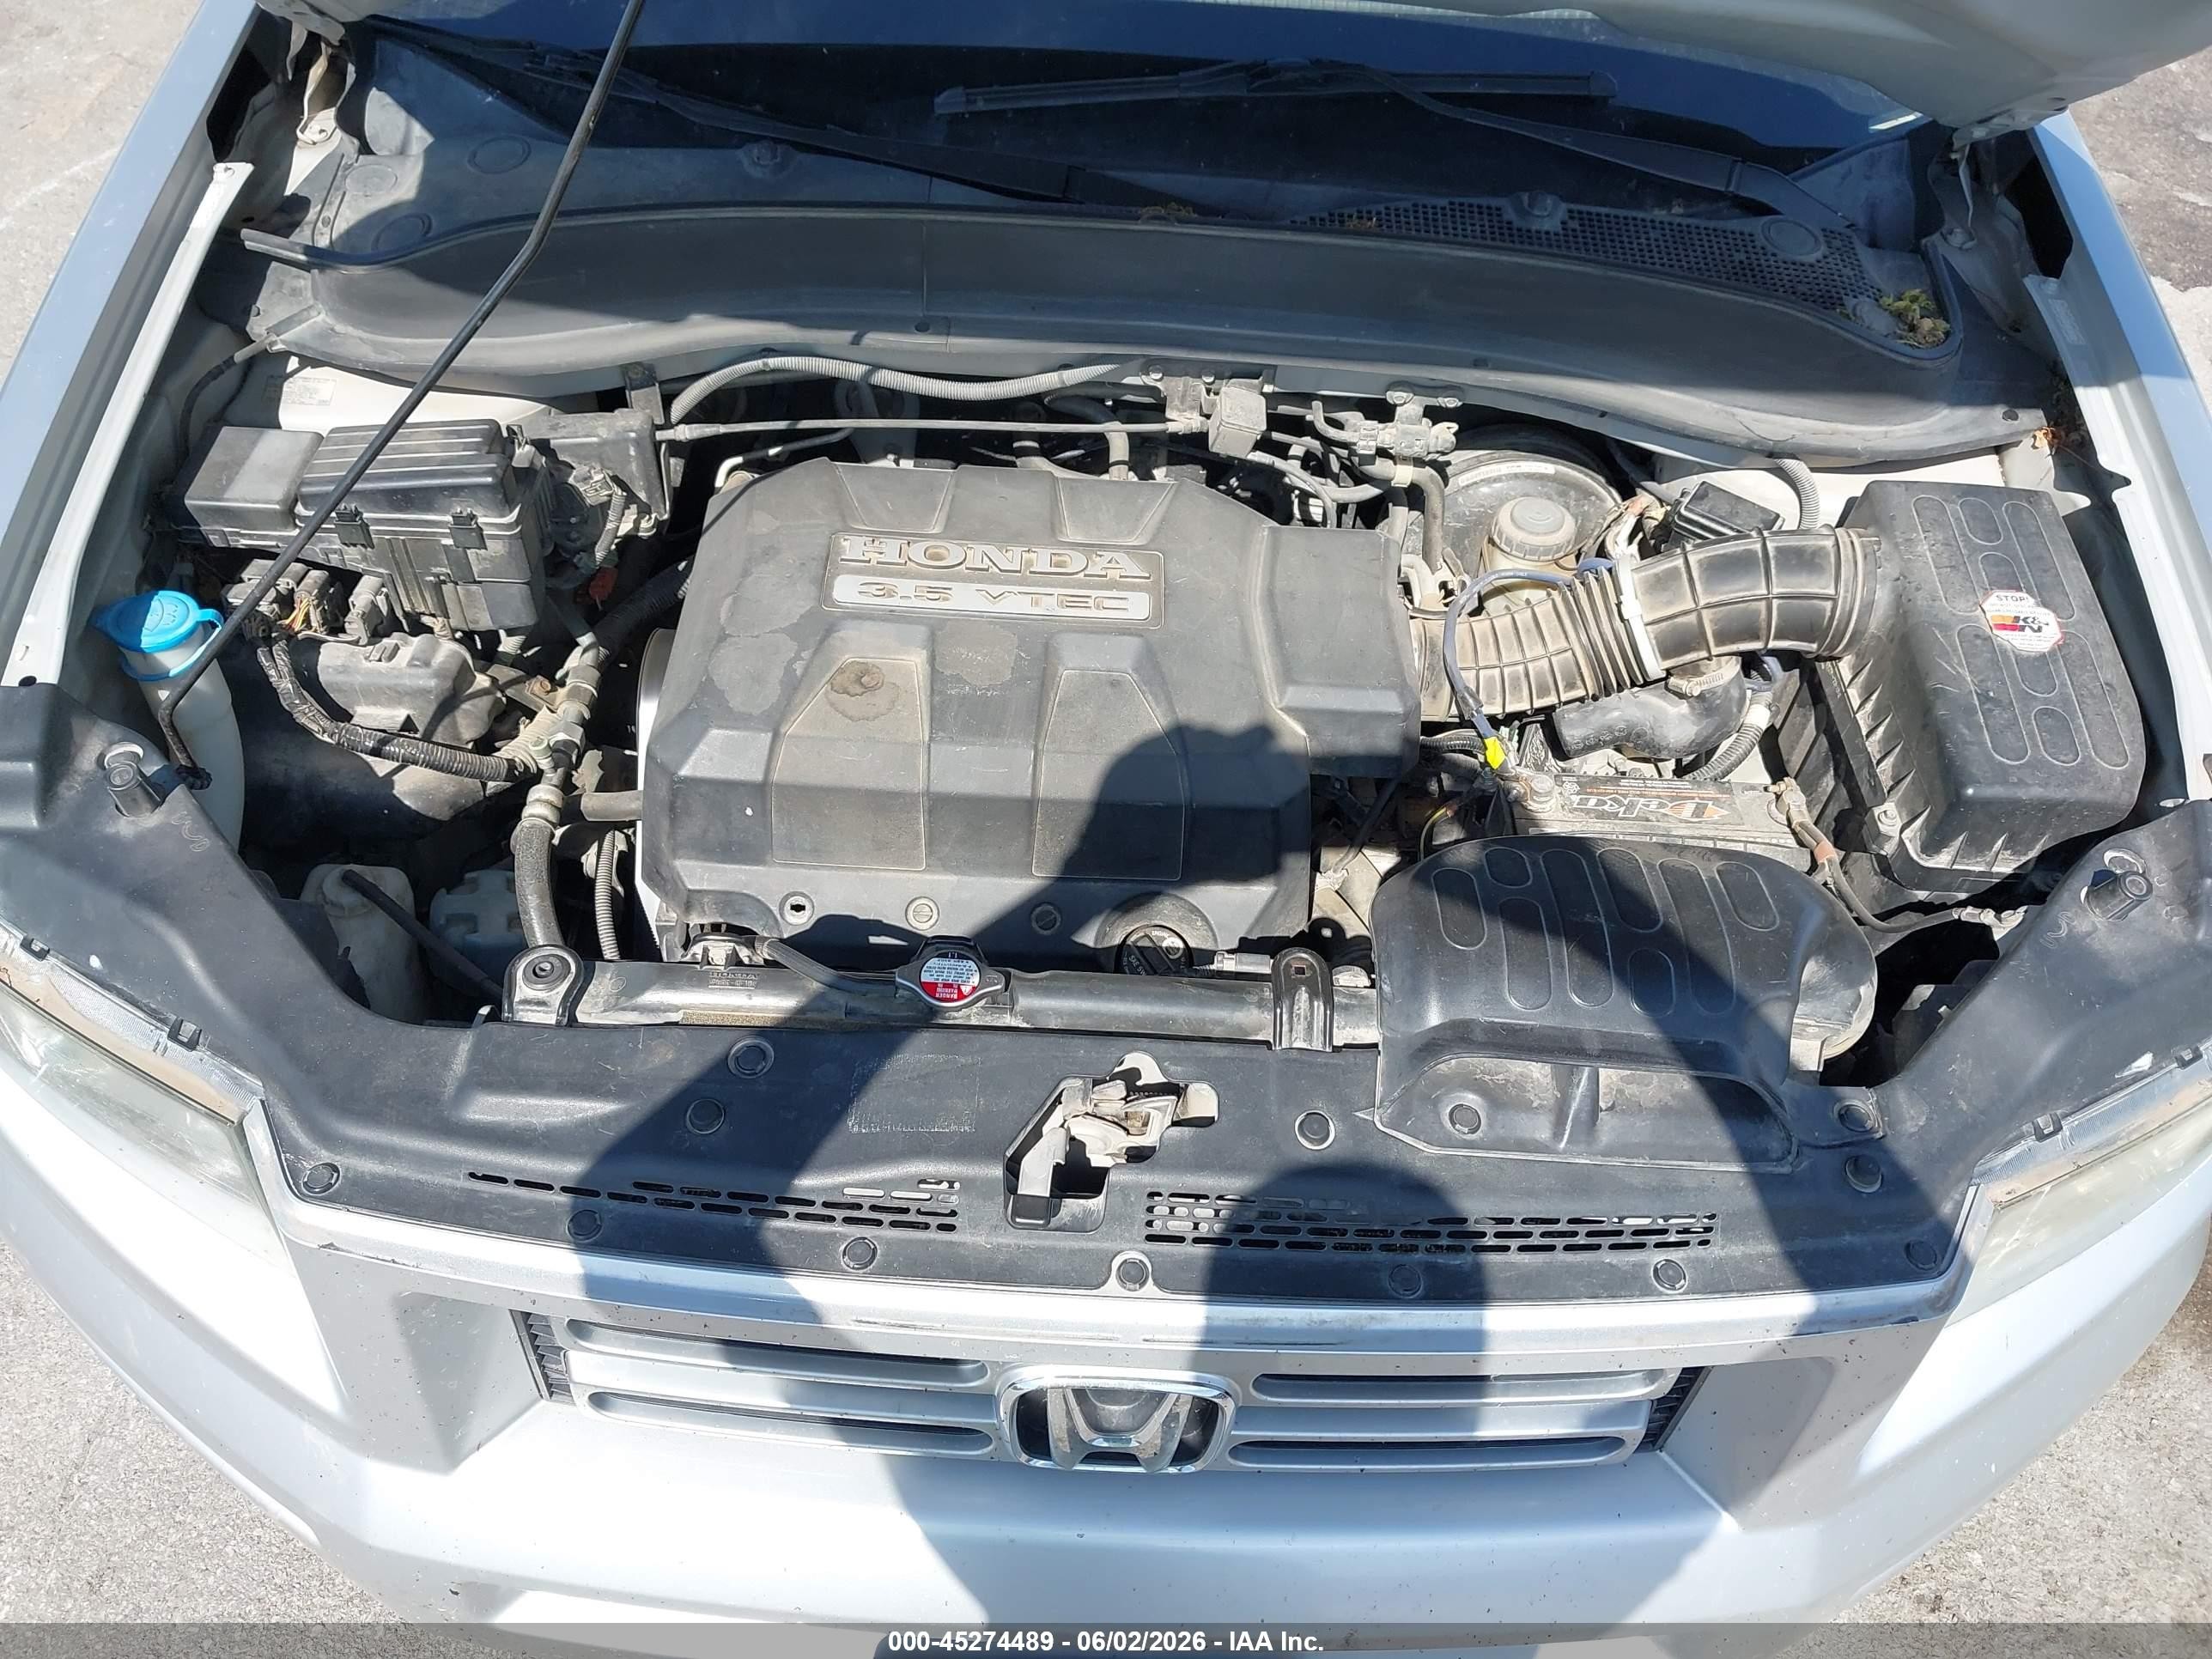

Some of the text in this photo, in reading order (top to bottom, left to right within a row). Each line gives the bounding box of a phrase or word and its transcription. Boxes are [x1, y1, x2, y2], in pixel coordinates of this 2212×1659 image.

[839, 535, 1152, 581] HONDA
[858, 580, 1130, 612] 3.5 VTEC
[1571, 794, 1729, 822] Deka
